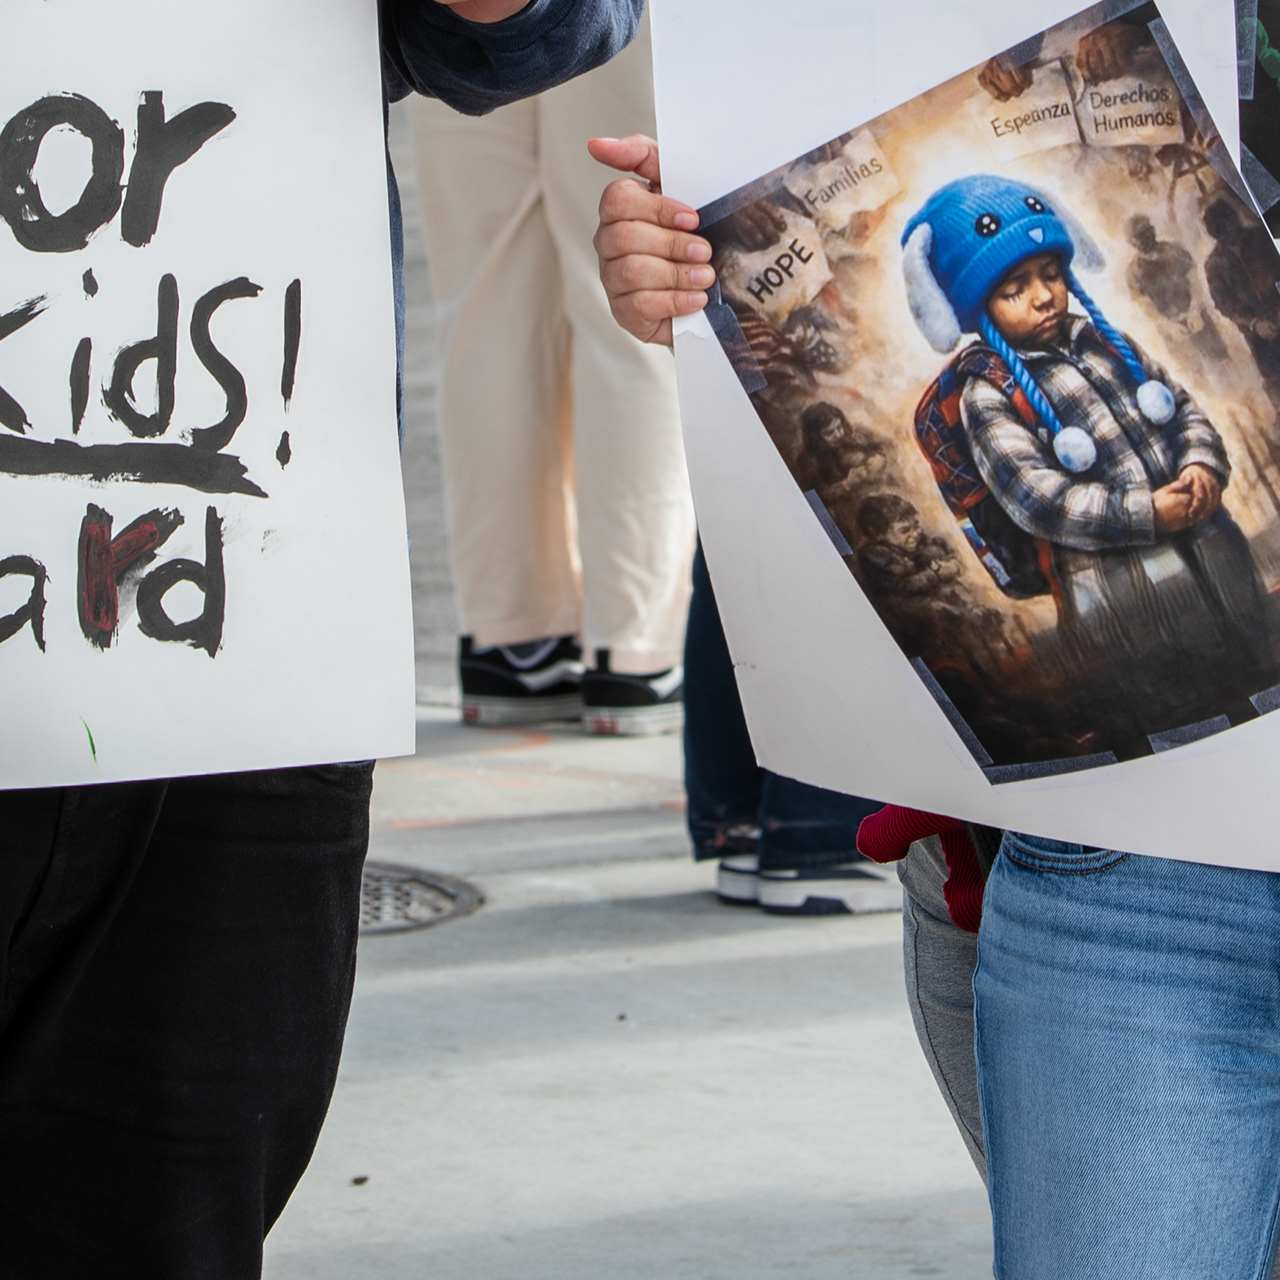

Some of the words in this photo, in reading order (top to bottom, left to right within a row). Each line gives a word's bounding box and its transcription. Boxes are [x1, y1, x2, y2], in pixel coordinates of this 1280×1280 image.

[1090, 83, 1170, 110] Derechos
[990, 102, 1072, 138] Espeanza
[1094, 110, 1176, 135] Humanos
[803, 156, 883, 210] Familias
[745, 238, 814, 305] HOPE
